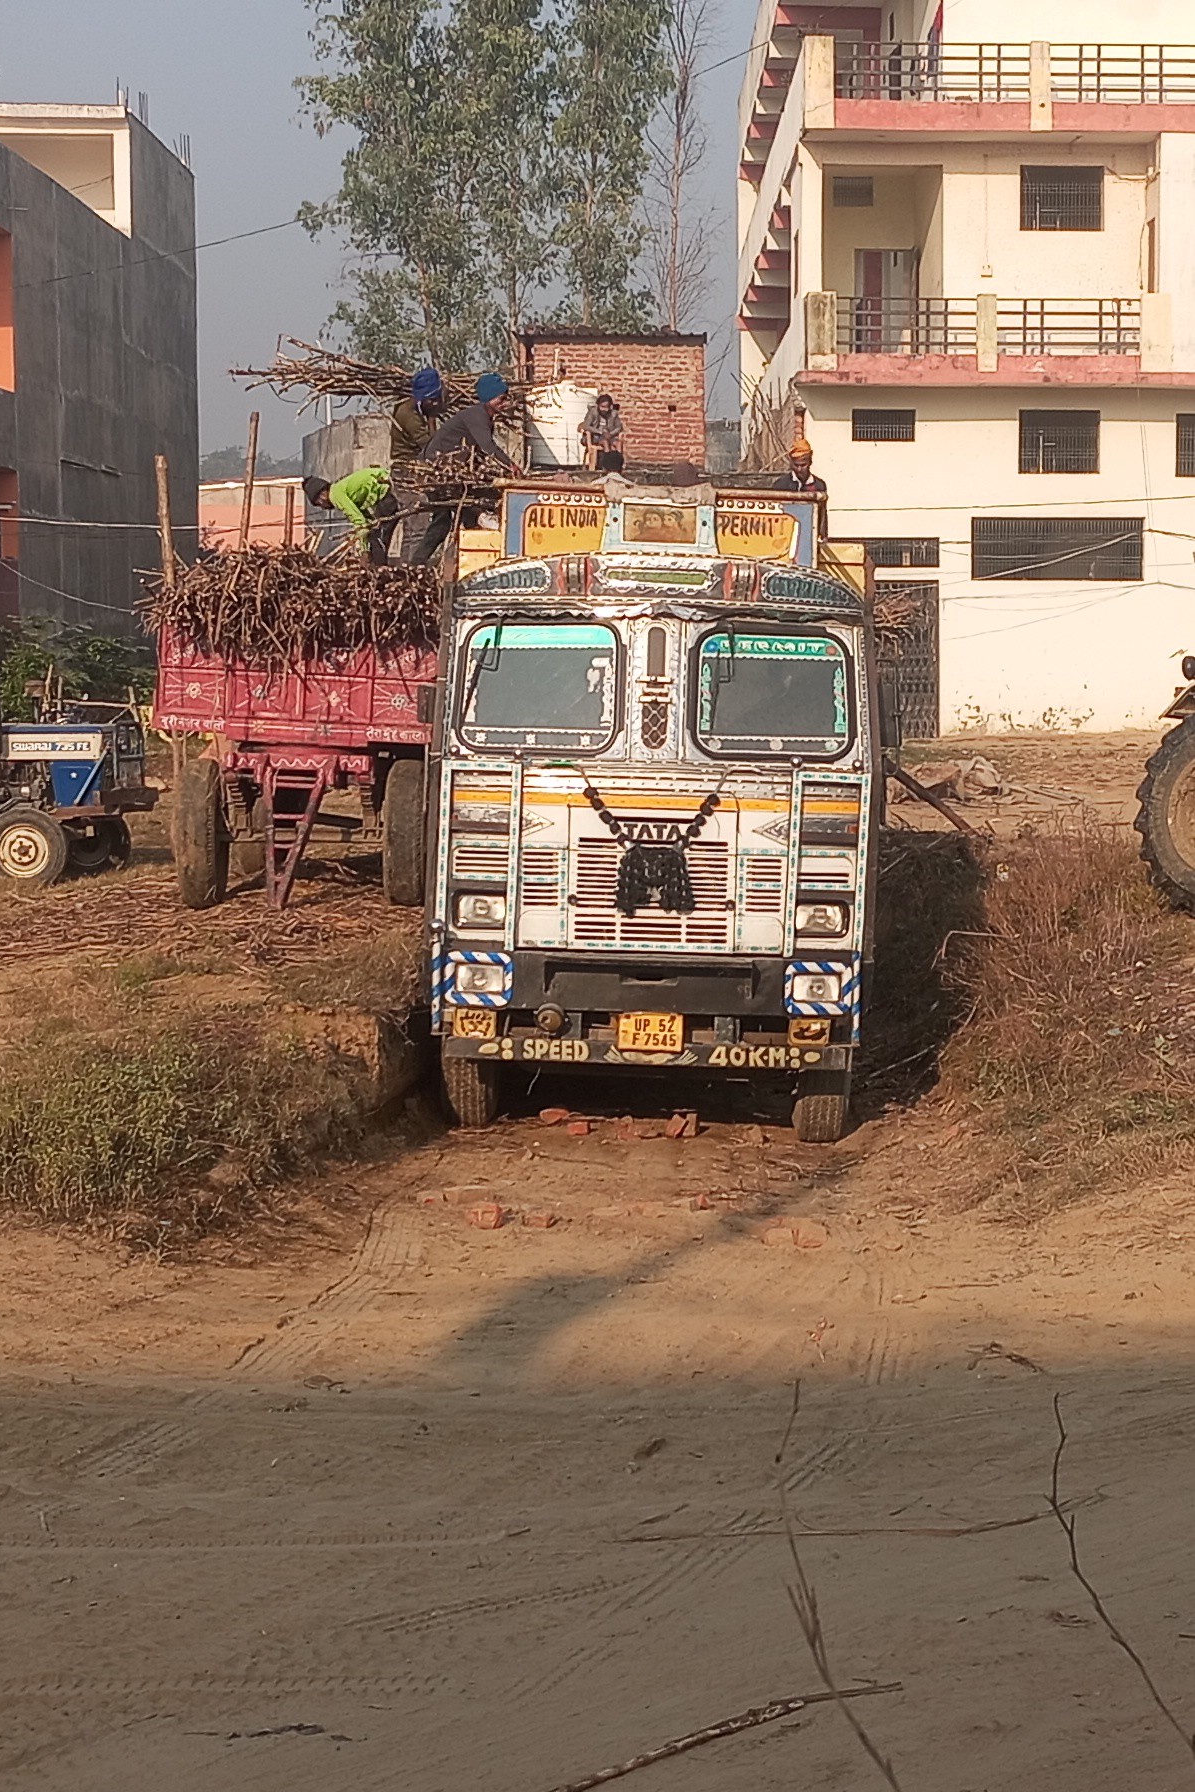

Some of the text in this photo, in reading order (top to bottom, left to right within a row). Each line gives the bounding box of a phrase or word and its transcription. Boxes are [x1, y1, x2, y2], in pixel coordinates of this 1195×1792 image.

[527, 508, 598, 528] ALL INDIA
[76, 742, 90, 751] FE
[624, 823, 683, 840] TATA
[634, 1018, 676, 1033] UP 52
[632, 1032, 677, 1047] F 7545
[522, 1038, 589, 1062] SPEED
